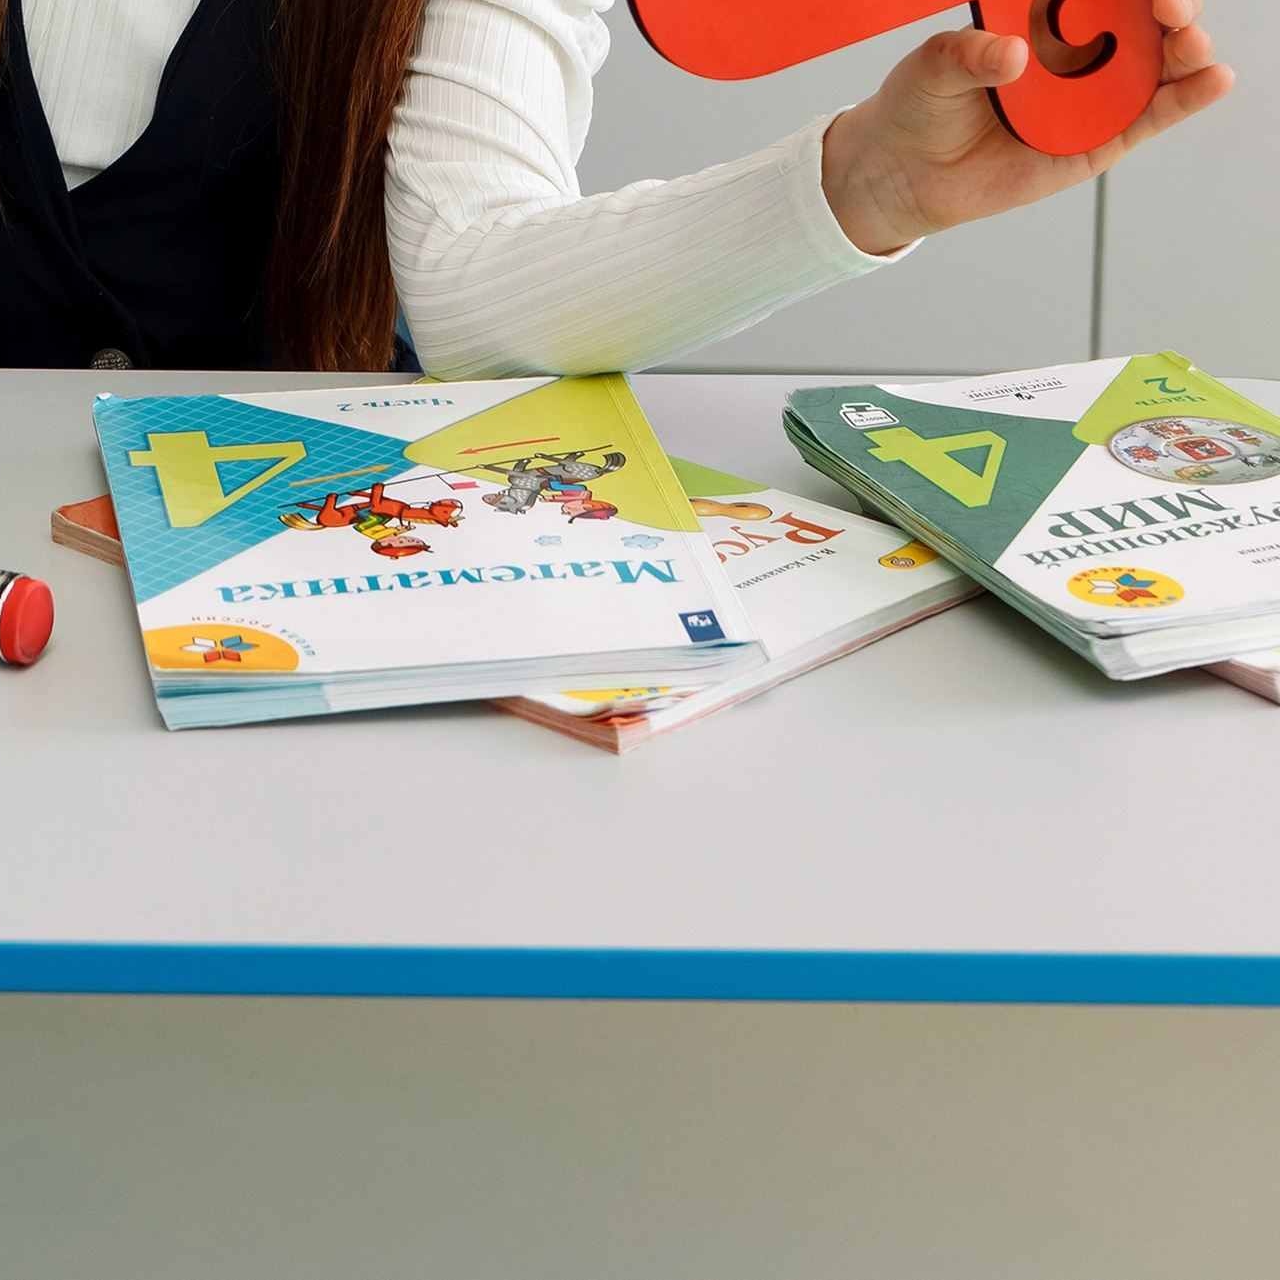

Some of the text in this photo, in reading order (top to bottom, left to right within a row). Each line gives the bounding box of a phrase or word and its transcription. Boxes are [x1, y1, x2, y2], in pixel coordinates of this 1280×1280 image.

[336, 398, 454, 412] Часть 2
[1143, 376, 1187, 394] 2
[128, 431, 308, 529] 4
[863, 427, 1008, 509] 4
[1048, 487, 1235, 538] МИР
[214, 558, 684, 604] Математика
[733, 559, 806, 590] Канакина
